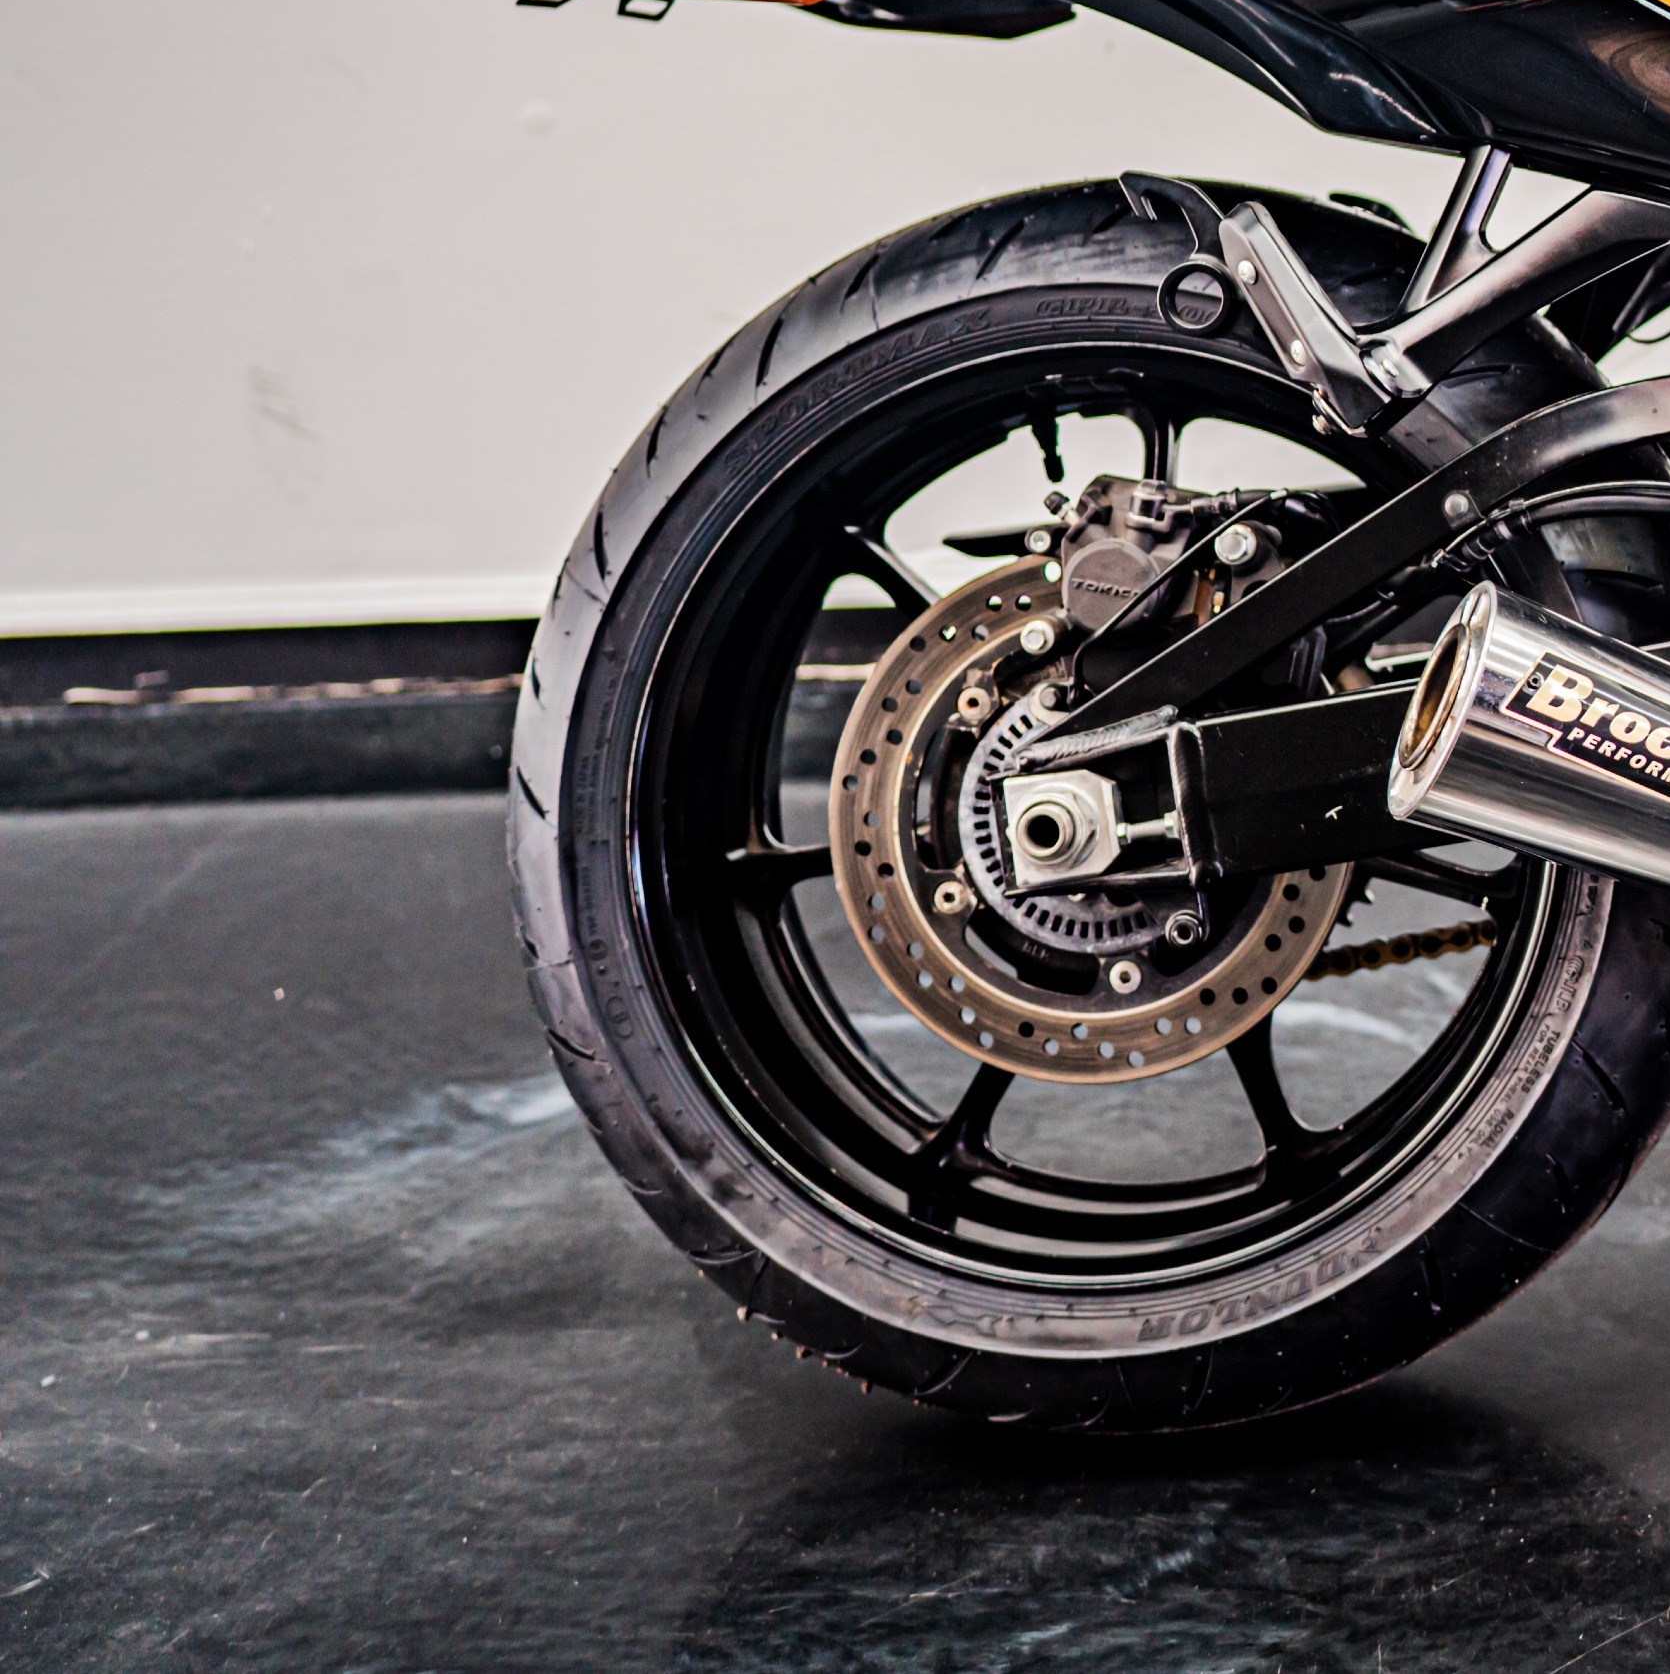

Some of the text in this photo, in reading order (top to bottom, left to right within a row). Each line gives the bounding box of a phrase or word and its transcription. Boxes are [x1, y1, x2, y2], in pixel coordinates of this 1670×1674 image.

[722, 307, 993, 481] SPORTMAX
[1520, 1045, 1539, 1073] REAR
[1535, 1021, 1551, 1044] FOR
[1482, 1028, 1560, 1152] TUBELESS RADIAL
[1483, 1106, 1502, 1128] USE
[1138, 1252, 1349, 1341] DUNLOP
